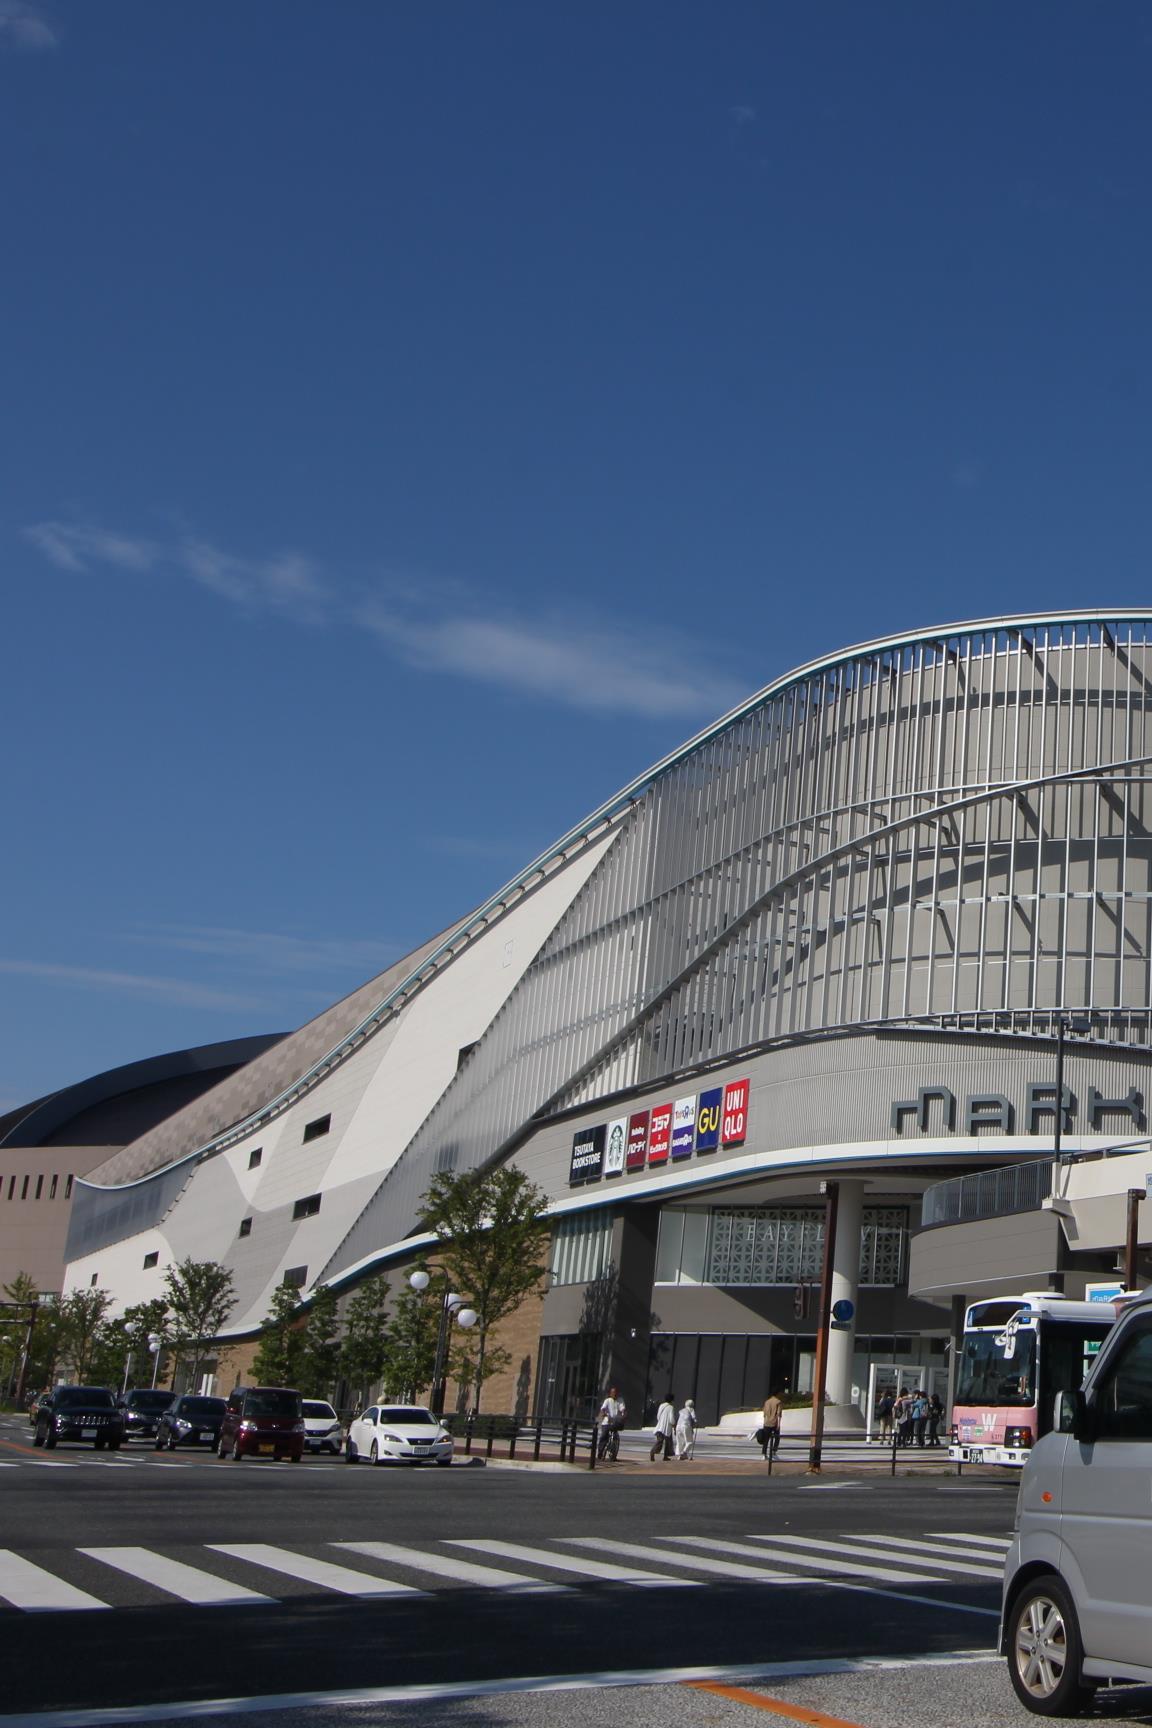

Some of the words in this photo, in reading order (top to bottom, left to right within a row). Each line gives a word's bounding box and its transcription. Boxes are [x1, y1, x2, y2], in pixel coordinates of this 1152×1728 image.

[727, 1088, 745, 1112] UNI
[698, 1105, 720, 1134] GU
[724, 1115, 744, 1139] QLO
[574, 1141, 594, 1156] TSUTAYA
[572, 1151, 601, 1170] BOOKSTORE
[981, 1414, 998, 1432] W
